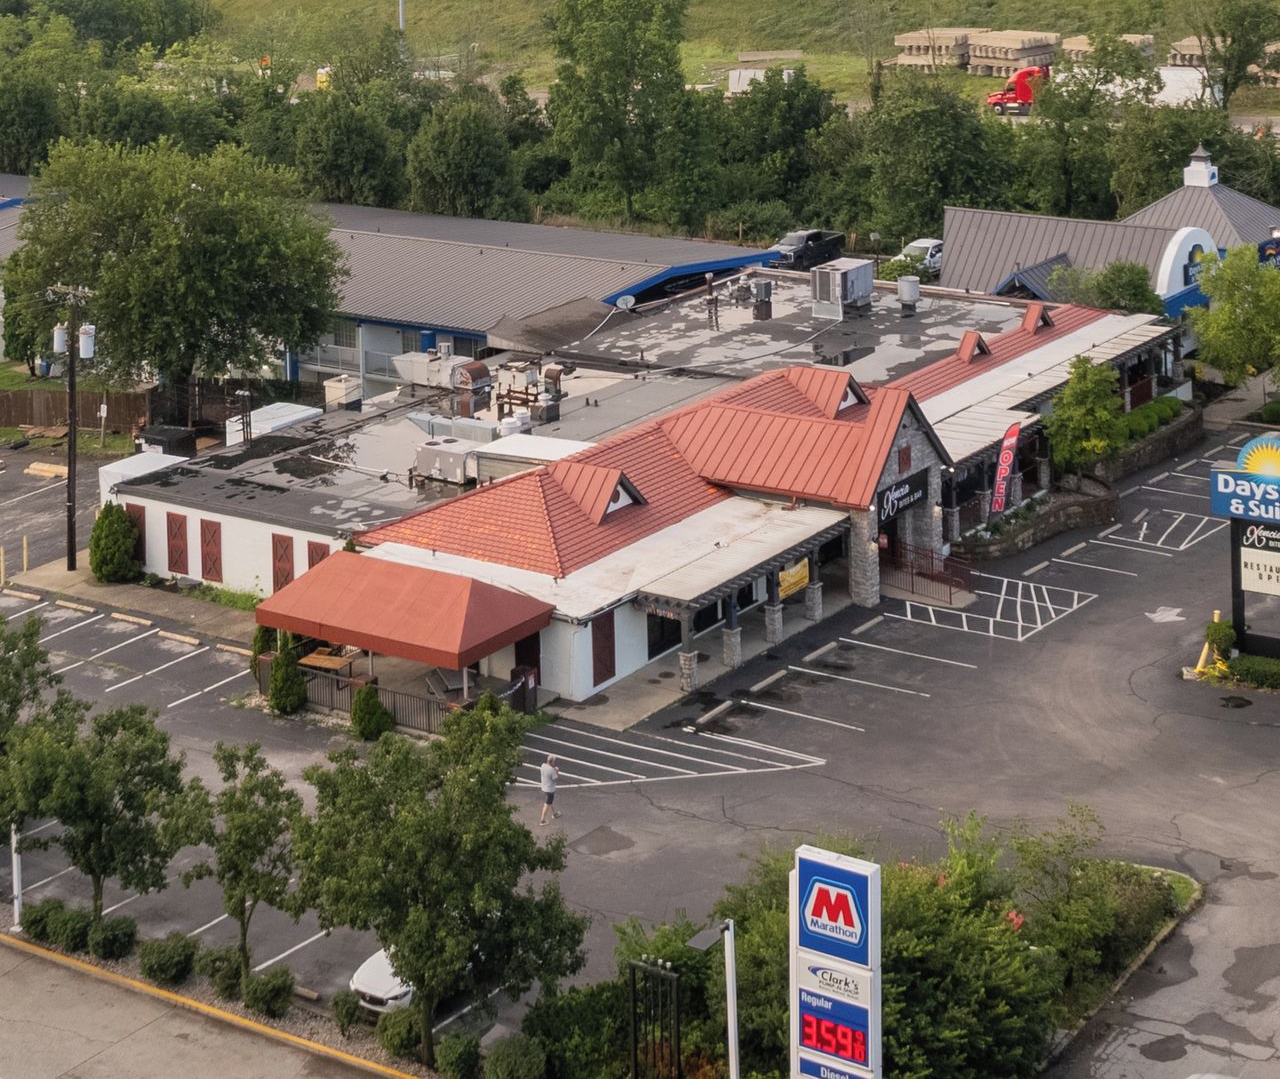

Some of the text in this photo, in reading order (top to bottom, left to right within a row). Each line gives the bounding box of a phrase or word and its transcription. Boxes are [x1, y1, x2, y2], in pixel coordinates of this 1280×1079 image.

[992, 450, 1013, 512] OPEN
[1217, 474, 1279, 500] Days
[1230, 499, 1245, 514] &
[811, 887, 855, 928] M
[810, 918, 858, 939] Marathon
[821, 971, 859, 991] Clark's
[801, 991, 832, 1010] Regular
[802, 1013, 852, 1060] 3.59
